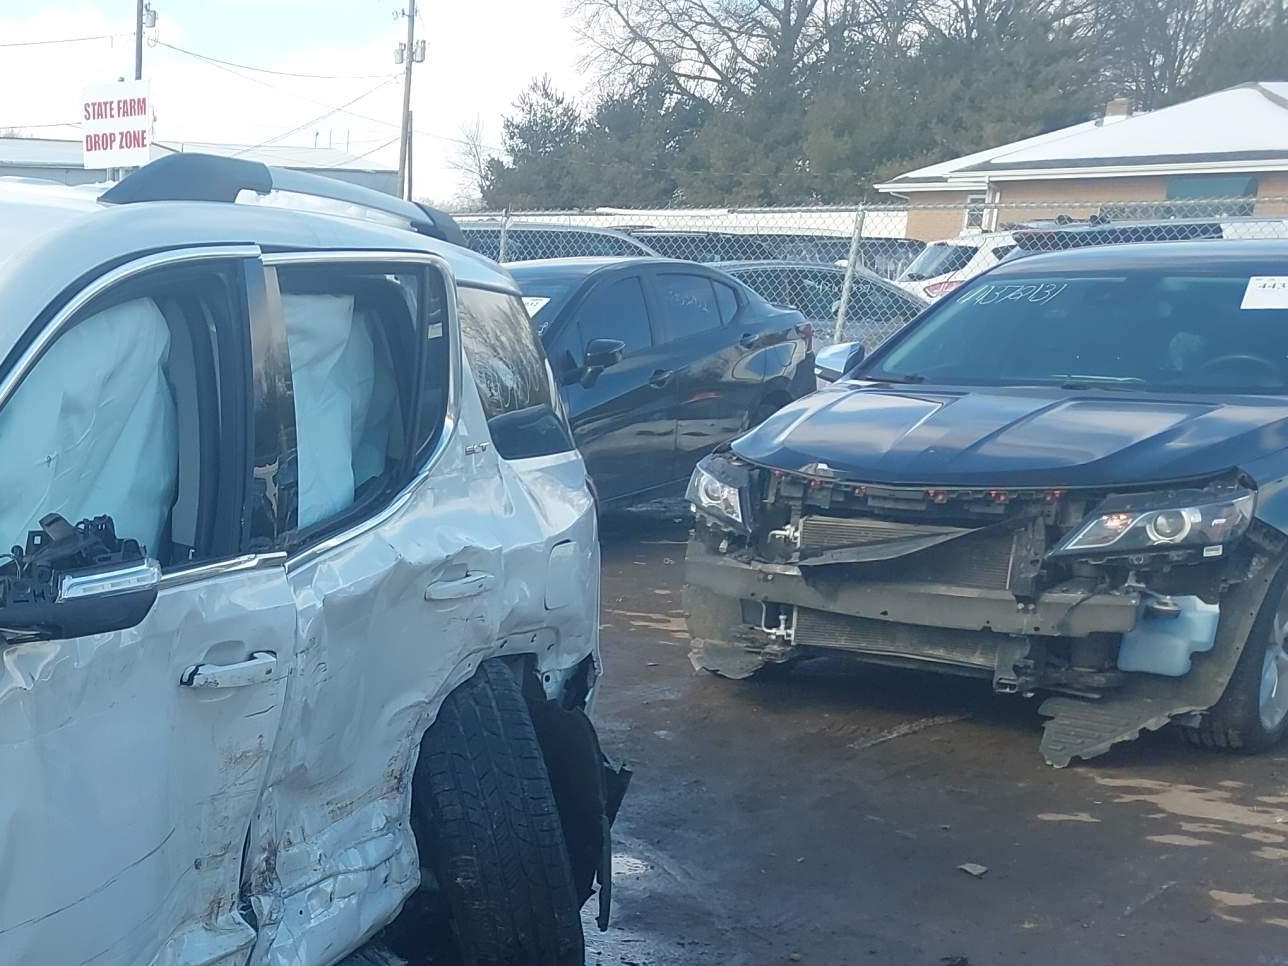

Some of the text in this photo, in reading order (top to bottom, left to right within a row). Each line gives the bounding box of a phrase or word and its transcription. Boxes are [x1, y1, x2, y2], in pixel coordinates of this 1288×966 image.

[84, 97, 147, 121] STATE FARM
[85, 130, 148, 152] DROP ZONE
